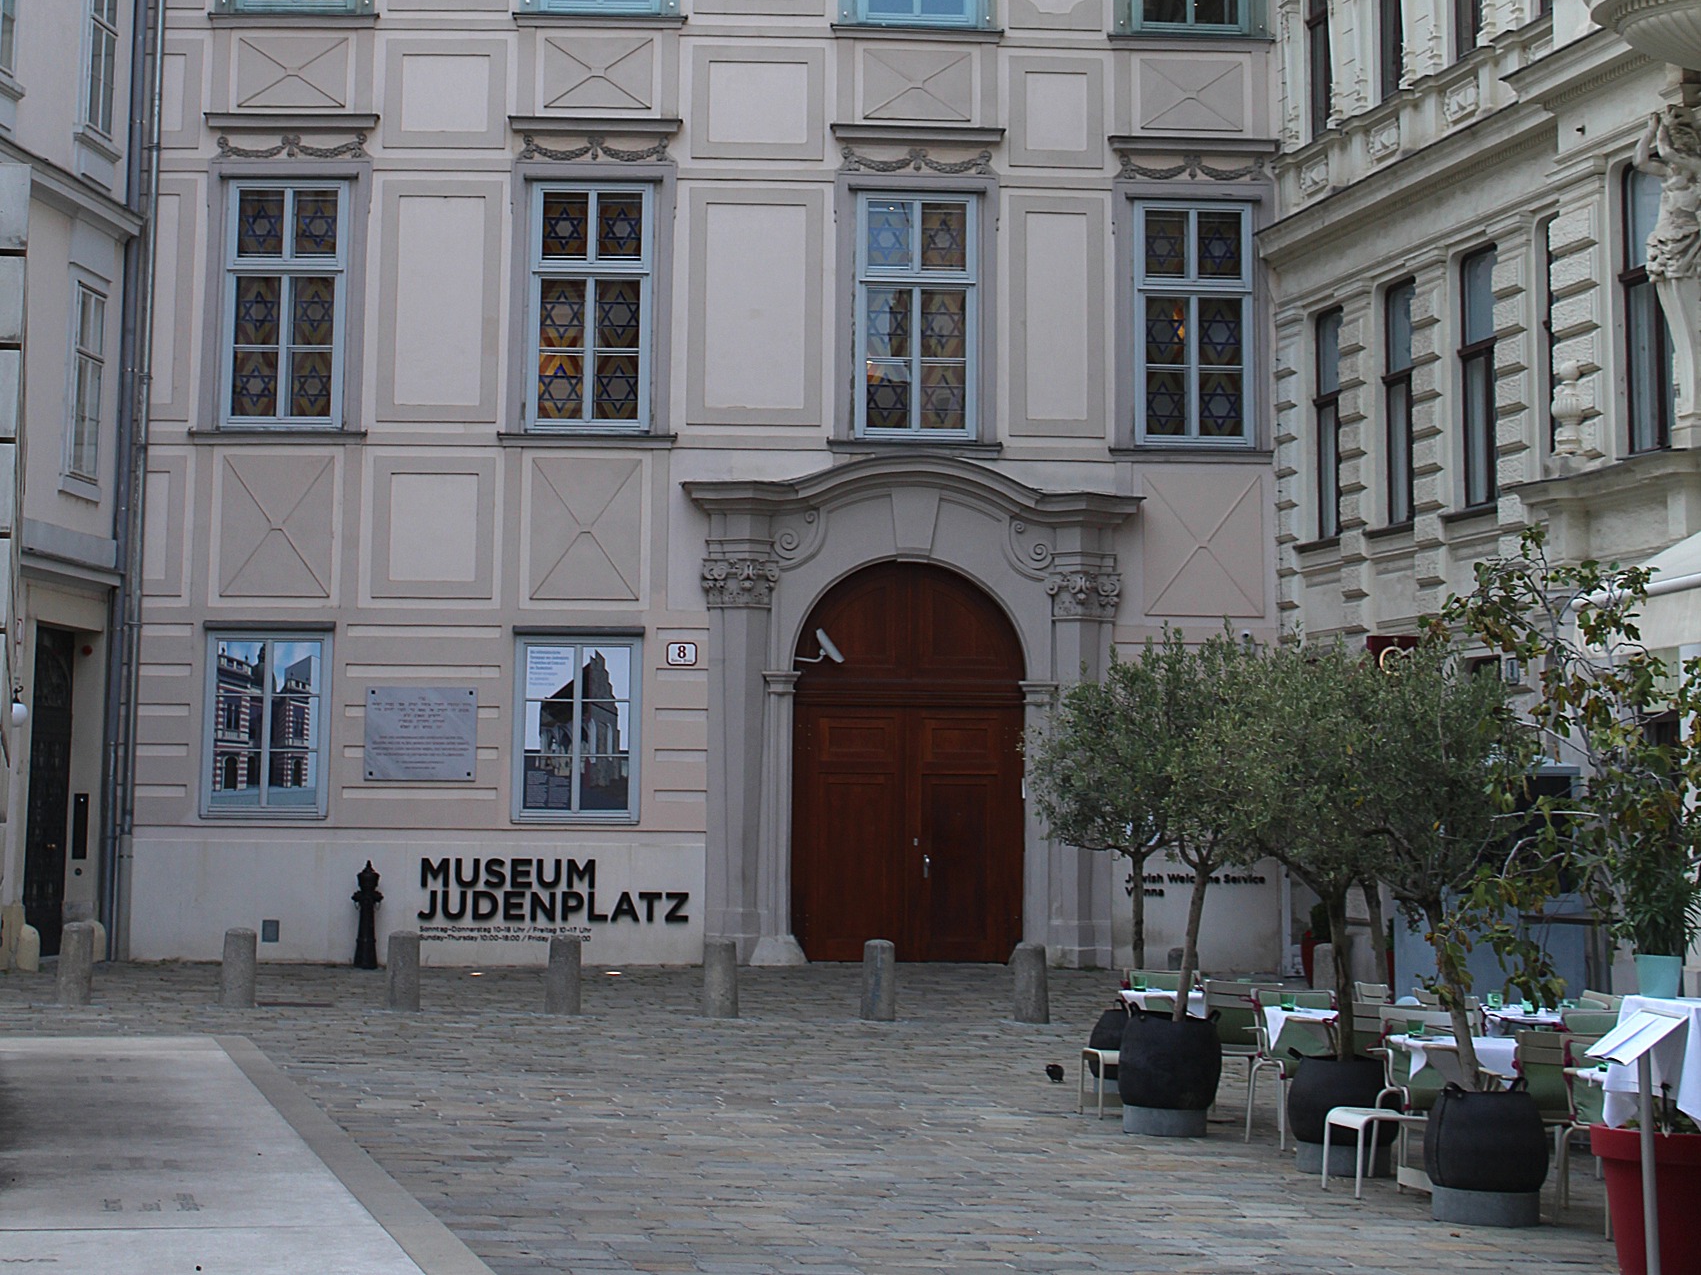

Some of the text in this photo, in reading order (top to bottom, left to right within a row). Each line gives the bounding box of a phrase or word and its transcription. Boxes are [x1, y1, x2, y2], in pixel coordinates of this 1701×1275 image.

[677, 645, 686, 659] 8
[421, 858, 595, 889] MUSEUM
[1125, 873, 1165, 884] Jwish
[1223, 874, 1265, 885] Service
[1125, 887, 1165, 897] Vnna
[417, 890, 690, 922] JUDENPLATZ
[533, 926, 557, 934] Freitag
